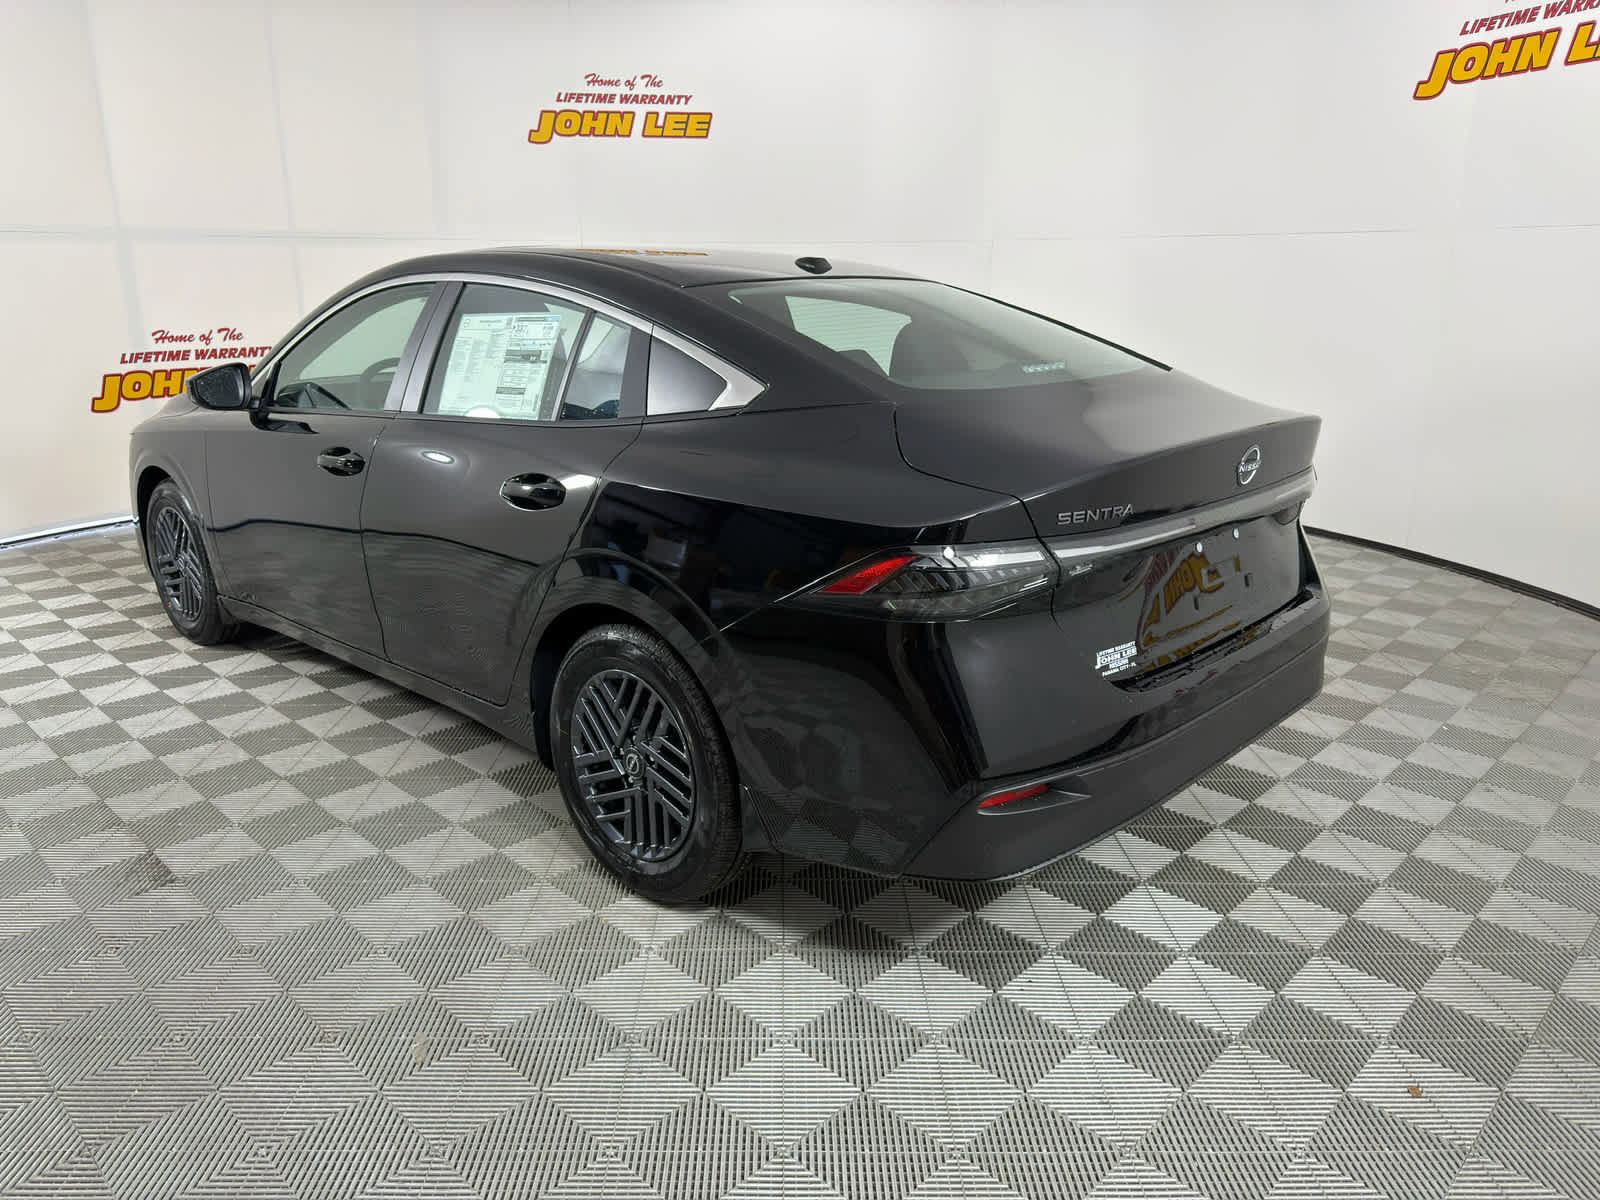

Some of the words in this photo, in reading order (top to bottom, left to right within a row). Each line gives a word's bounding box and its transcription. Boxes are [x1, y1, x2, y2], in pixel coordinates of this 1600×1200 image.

[1460, 6, 1541, 35] LIFETIME
[1413, 27, 1562, 100] JOHN
[584, 73, 621, 88] Home
[624, 76, 636, 90] of
[640, 74, 663, 88] The
[556, 92, 616, 104] LIFETIME
[619, 93, 693, 105] WARRANTY
[528, 110, 635, 144] JOHN
[642, 112, 712, 139] LEE
[152, 329, 195, 344] Home
[199, 329, 213, 345] of
[217, 328, 243, 342] The
[120, 350, 190, 364] LIFETIME
[195, 346, 272, 361] WARRANT
[1057, 504, 1134, 525] SENTRA
